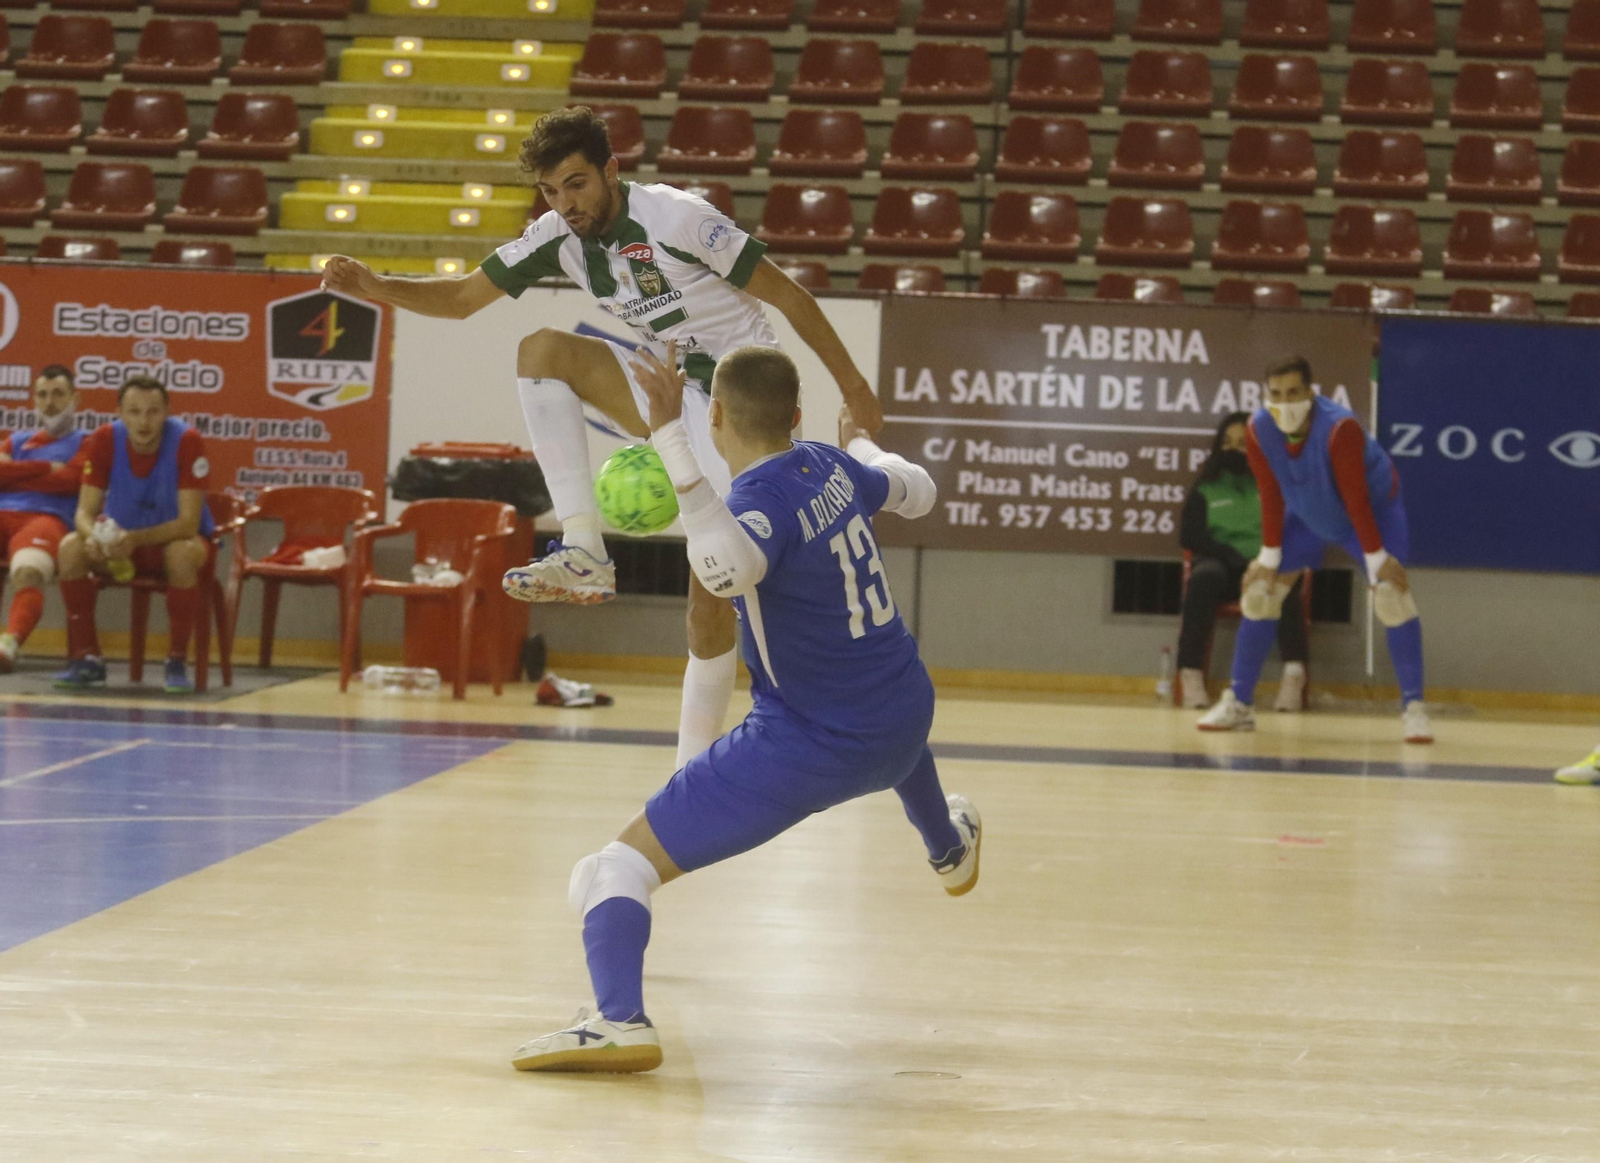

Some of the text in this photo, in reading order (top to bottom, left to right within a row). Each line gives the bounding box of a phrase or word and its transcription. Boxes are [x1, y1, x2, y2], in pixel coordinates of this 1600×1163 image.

[55, 304, 249, 339] Estaciones
[133, 339, 166, 359] de
[1041, 323, 1210, 366] TABERNA
[275, 361, 369, 383] RUTA
[894, 367, 938, 402] LA
[950, 366, 1085, 410] SARTÉN
[1096, 375, 1144, 412] DE
[1157, 377, 1205, 414] LA
[195, 413, 253, 438] Mejor
[923, 437, 956, 463] C/
[965, 438, 1057, 467] Manuel
[1064, 443, 1129, 471] Cano
[1389, 422, 1526, 464] ZOC
[957, 470, 1021, 498] Plaza
[1121, 478, 1185, 502] Prats
[999, 502, 1051, 530] 957
[1060, 504, 1115, 531] 453
[1123, 507, 1175, 534] 226
[828, 513, 895, 640] 13
